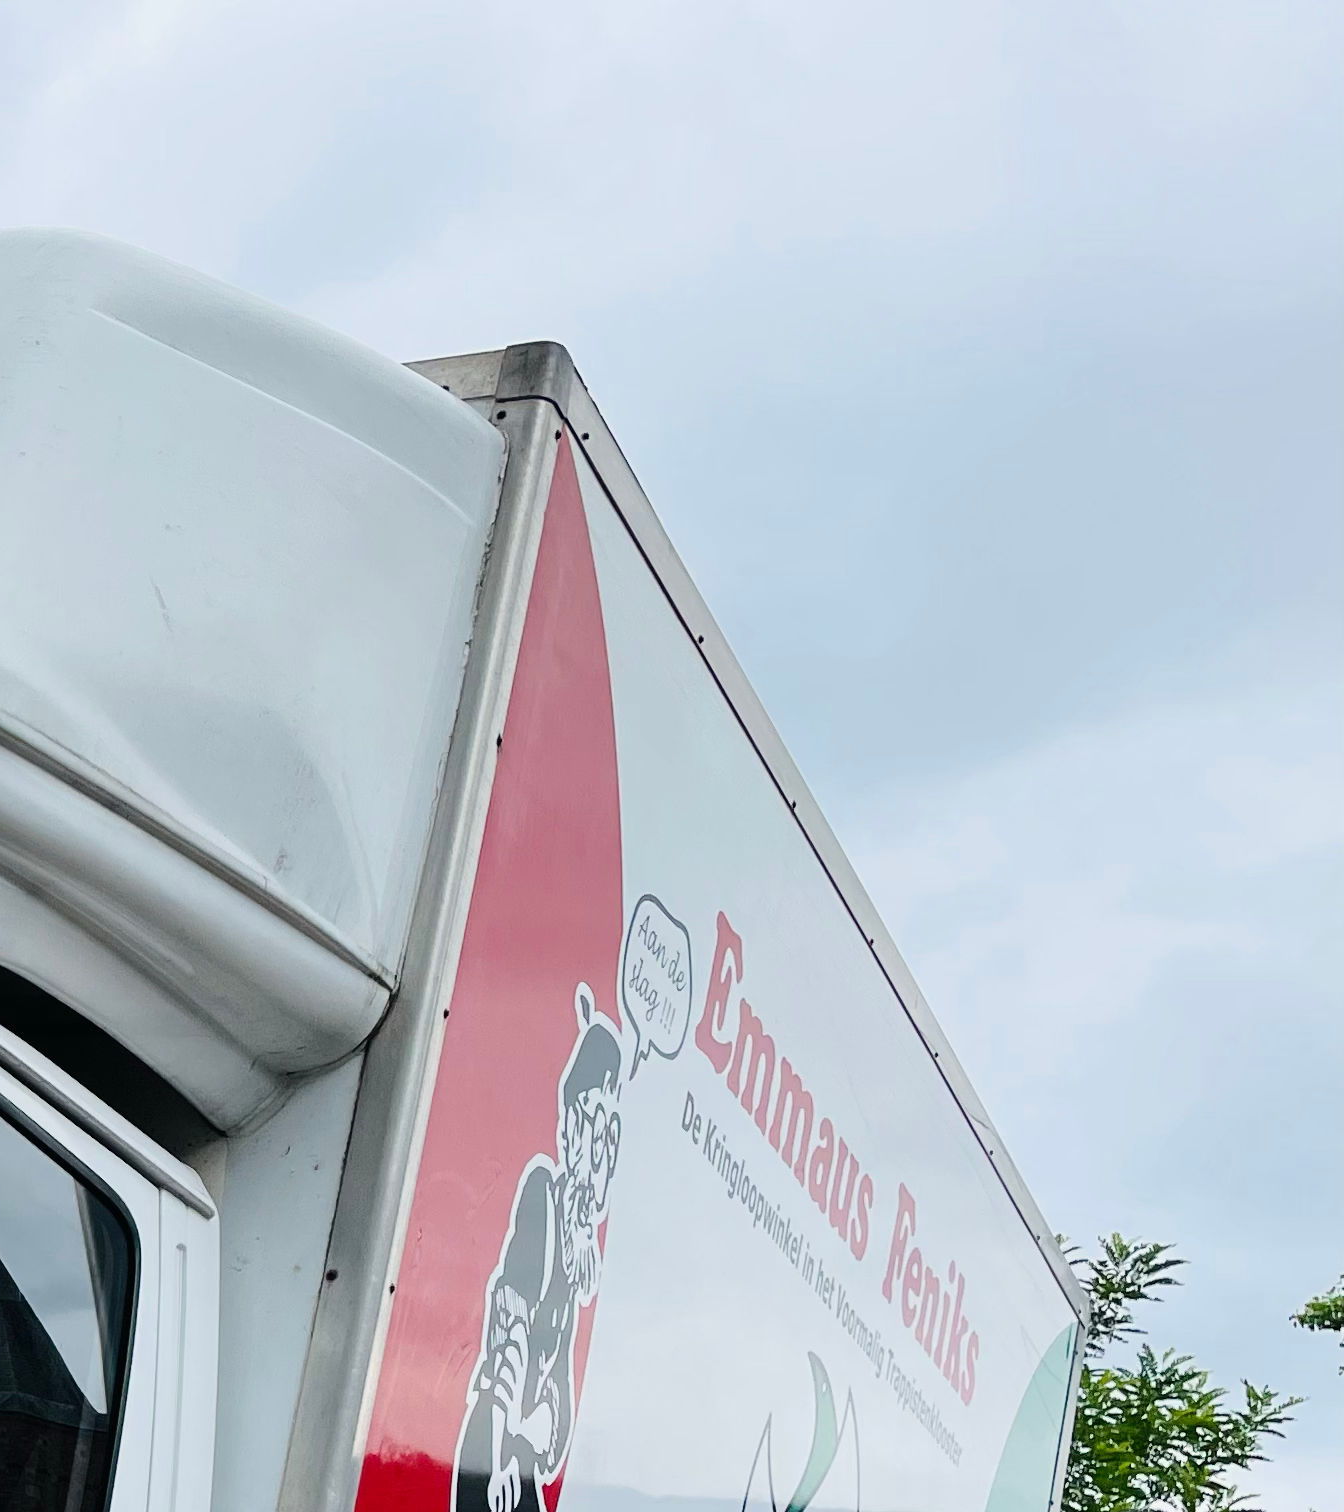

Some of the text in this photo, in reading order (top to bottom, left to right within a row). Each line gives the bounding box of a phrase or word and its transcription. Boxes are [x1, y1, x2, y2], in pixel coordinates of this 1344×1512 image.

[637, 915, 687, 992] Aan de
[681, 1090, 964, 1468] De Kringloopwinkel in het Voormalig Trappistenklooster
[694, 910, 980, 1407] Emmaus Feniks
